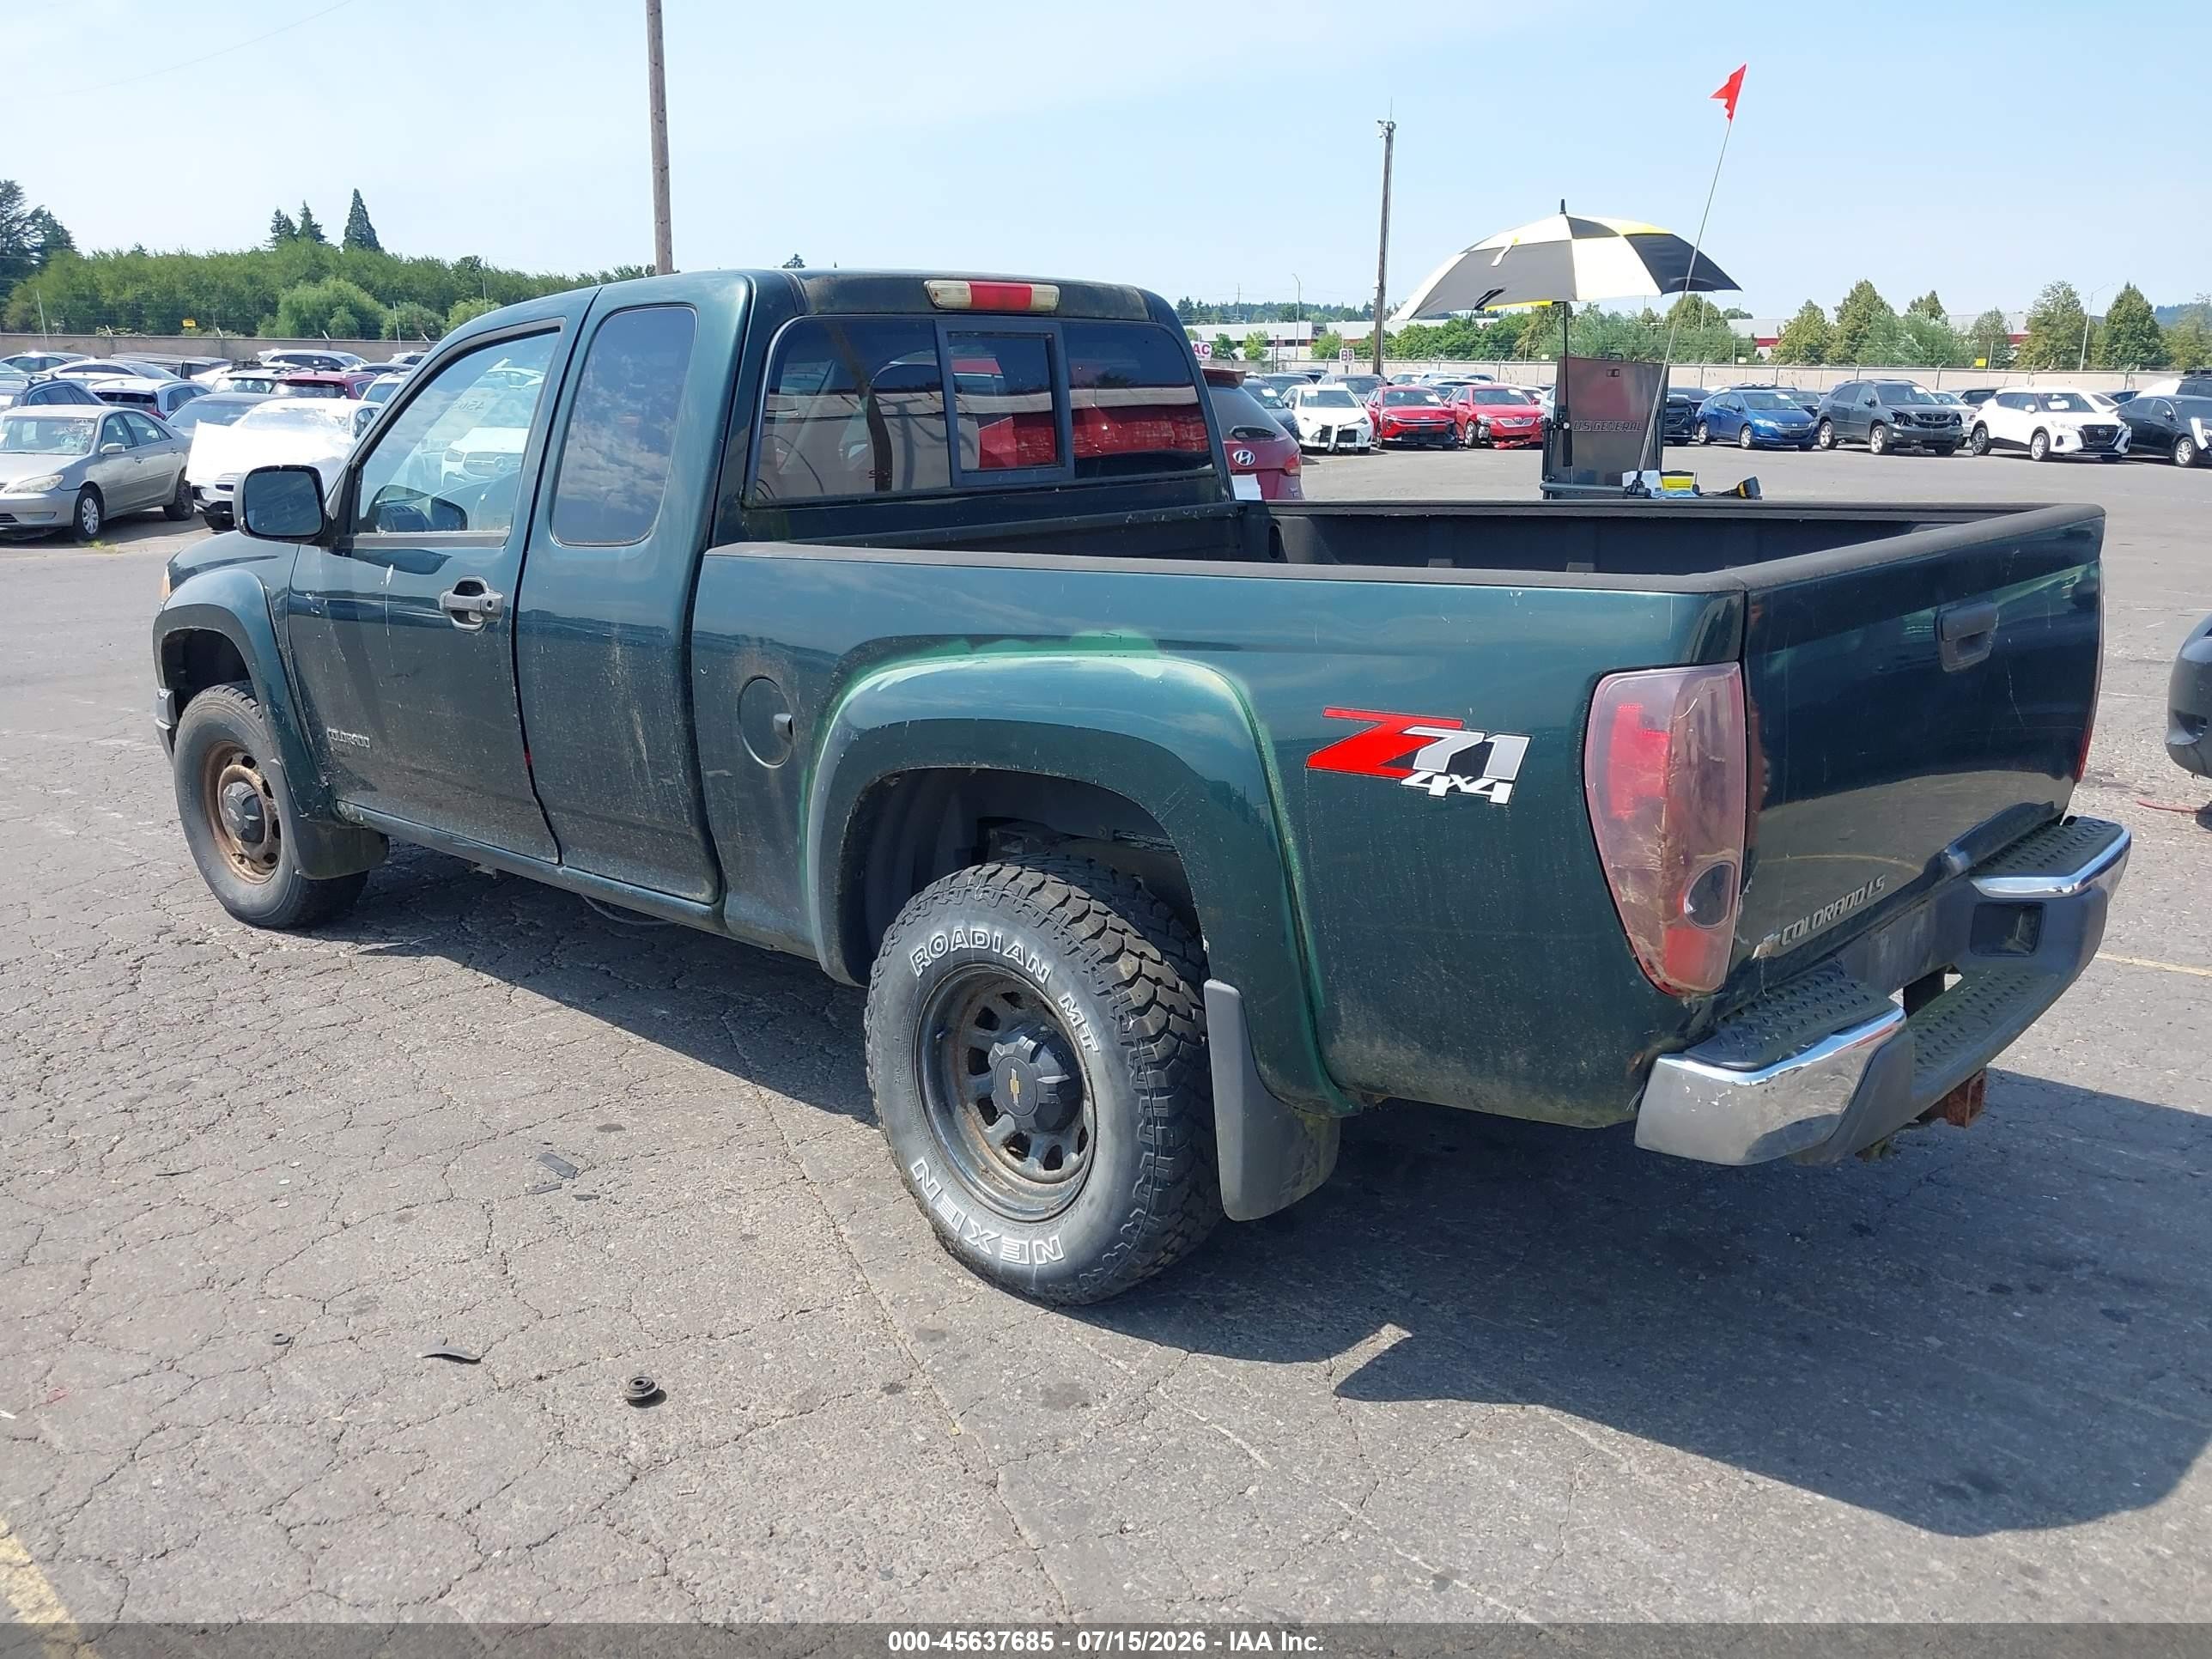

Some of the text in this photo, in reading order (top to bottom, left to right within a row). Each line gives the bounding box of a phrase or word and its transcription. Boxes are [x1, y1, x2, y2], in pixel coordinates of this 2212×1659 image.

[1592, 420, 1643, 432] GENERAL
[1305, 707, 1533, 781] Z71
[1781, 875, 1887, 945] COLORADO LS
[908, 927, 1101, 1053] ROADIAN MT
[910, 1156, 1066, 1266] NEXEN
